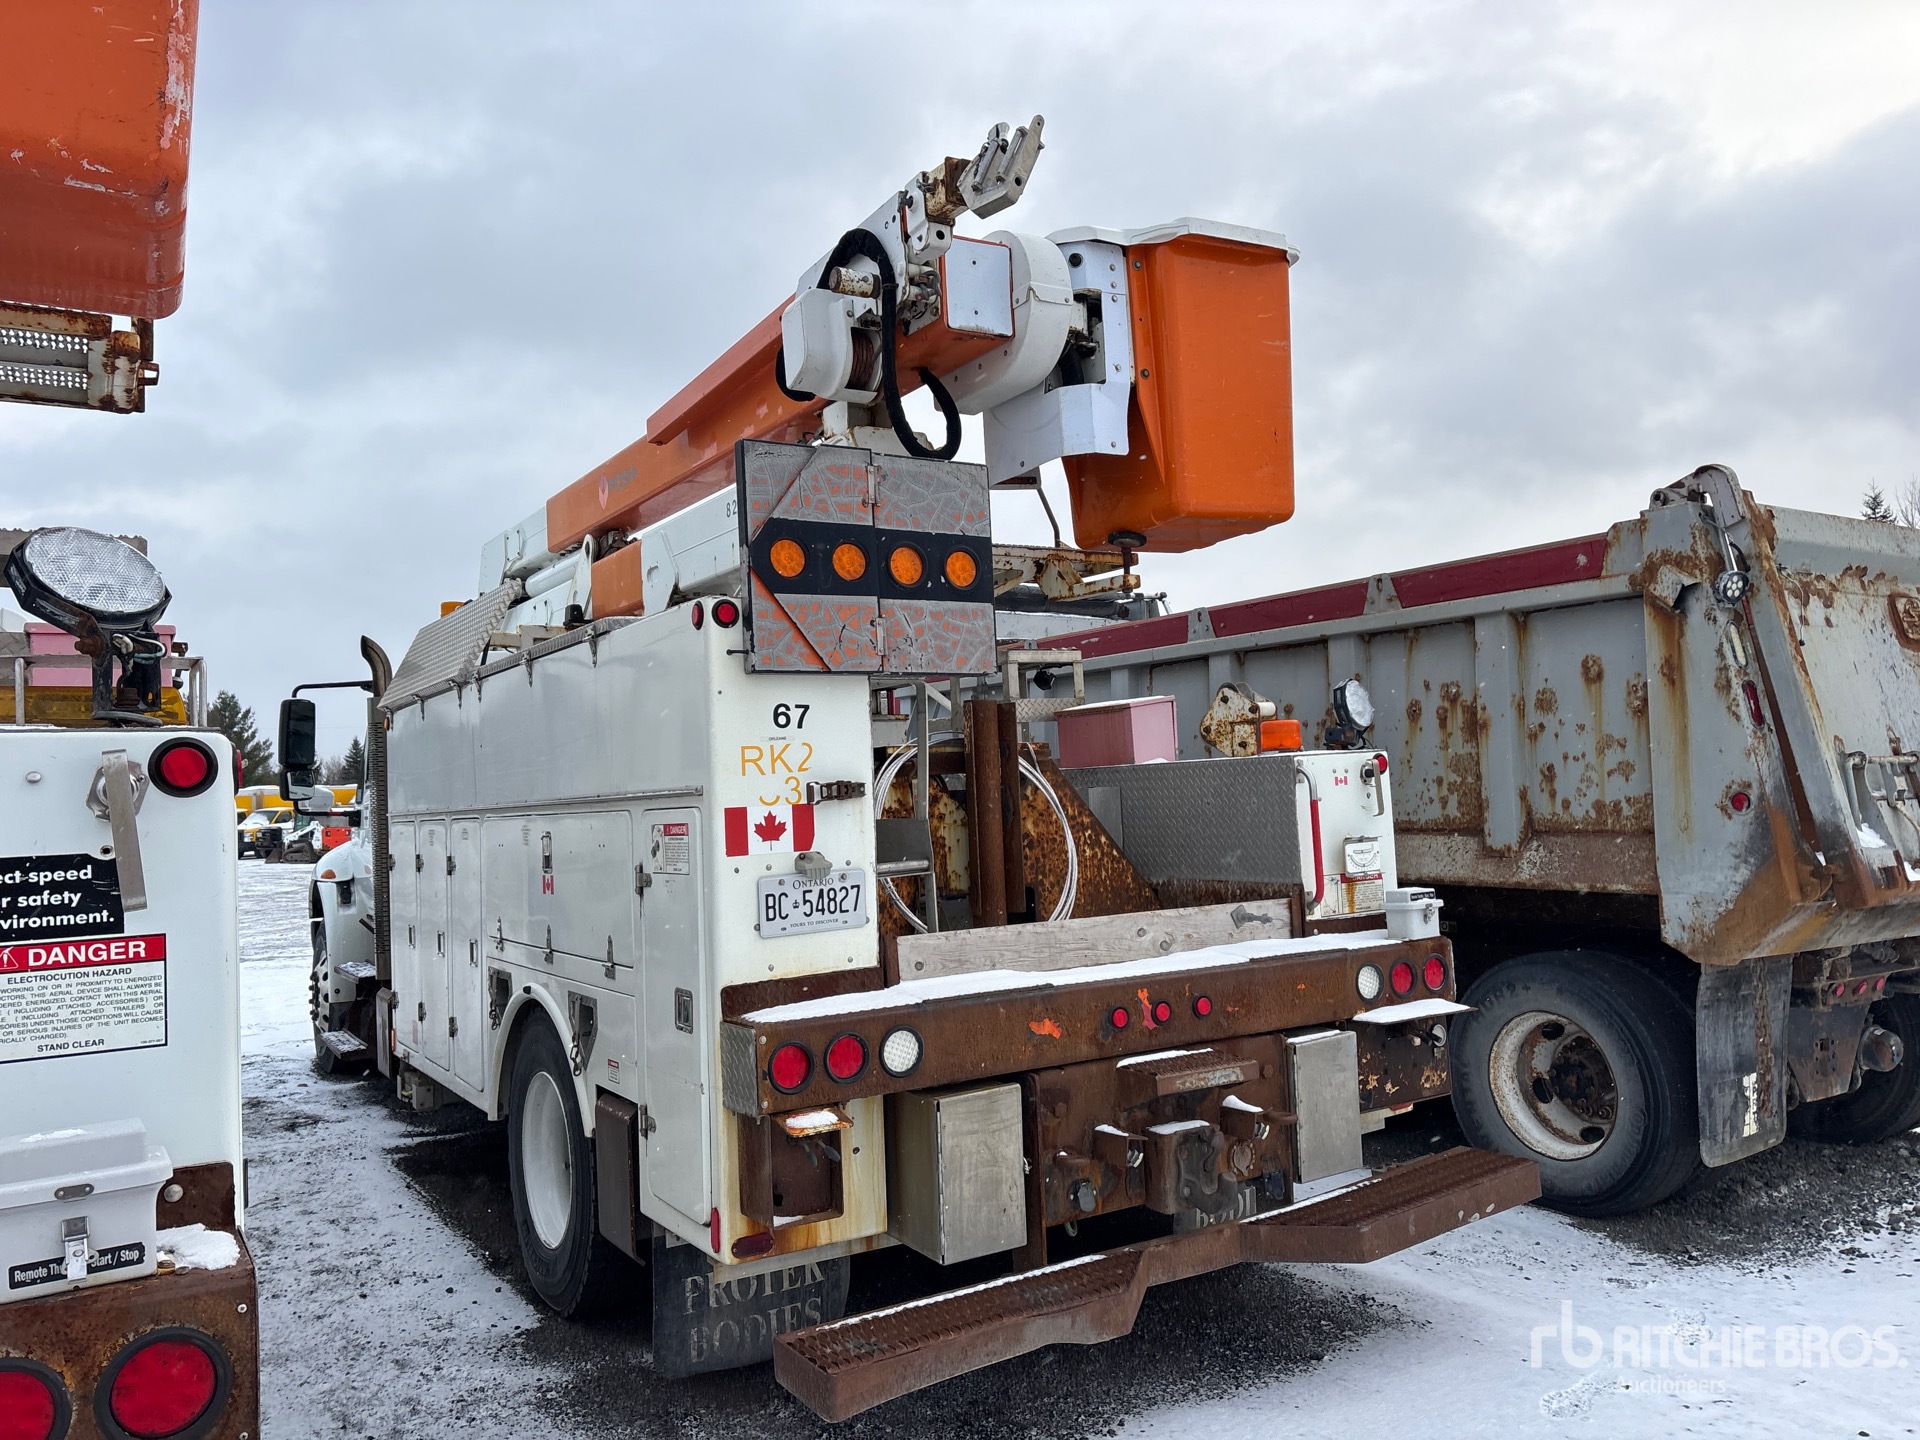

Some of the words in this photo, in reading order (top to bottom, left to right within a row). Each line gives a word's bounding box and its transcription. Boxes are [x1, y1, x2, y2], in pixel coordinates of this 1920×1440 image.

[773, 703, 810, 729] 67
[740, 742, 813, 776] RK2
[670, 826, 686, 834] DANGER
[28, 864, 92, 885] speed
[792, 878, 834, 890] ONTARIO
[18, 890, 82, 907] safety
[765, 892, 789, 922] BC
[803, 885, 860, 917] 54827
[28, 941, 146, 966] DANGER
[7, 971, 90, 984] ELECTROCUTION
[92, 967, 132, 977] HAZARD
[14, 1006, 51, 1014] INCLUDING
[57, 1002, 91, 1010] ATTACHED
[22, 1012, 59, 1021] INCLUDING
[81, 1013, 122, 1022] CONDITIONS
[17, 1027, 48, 1035] SERIOUS
[37, 1042, 69, 1052] STAND
[72, 1039, 104, 1048] CLEAR
[14, 1265, 47, 1282] Remote
[113, 1251, 118, 1266] /
[120, 1249, 139, 1262] Stop
